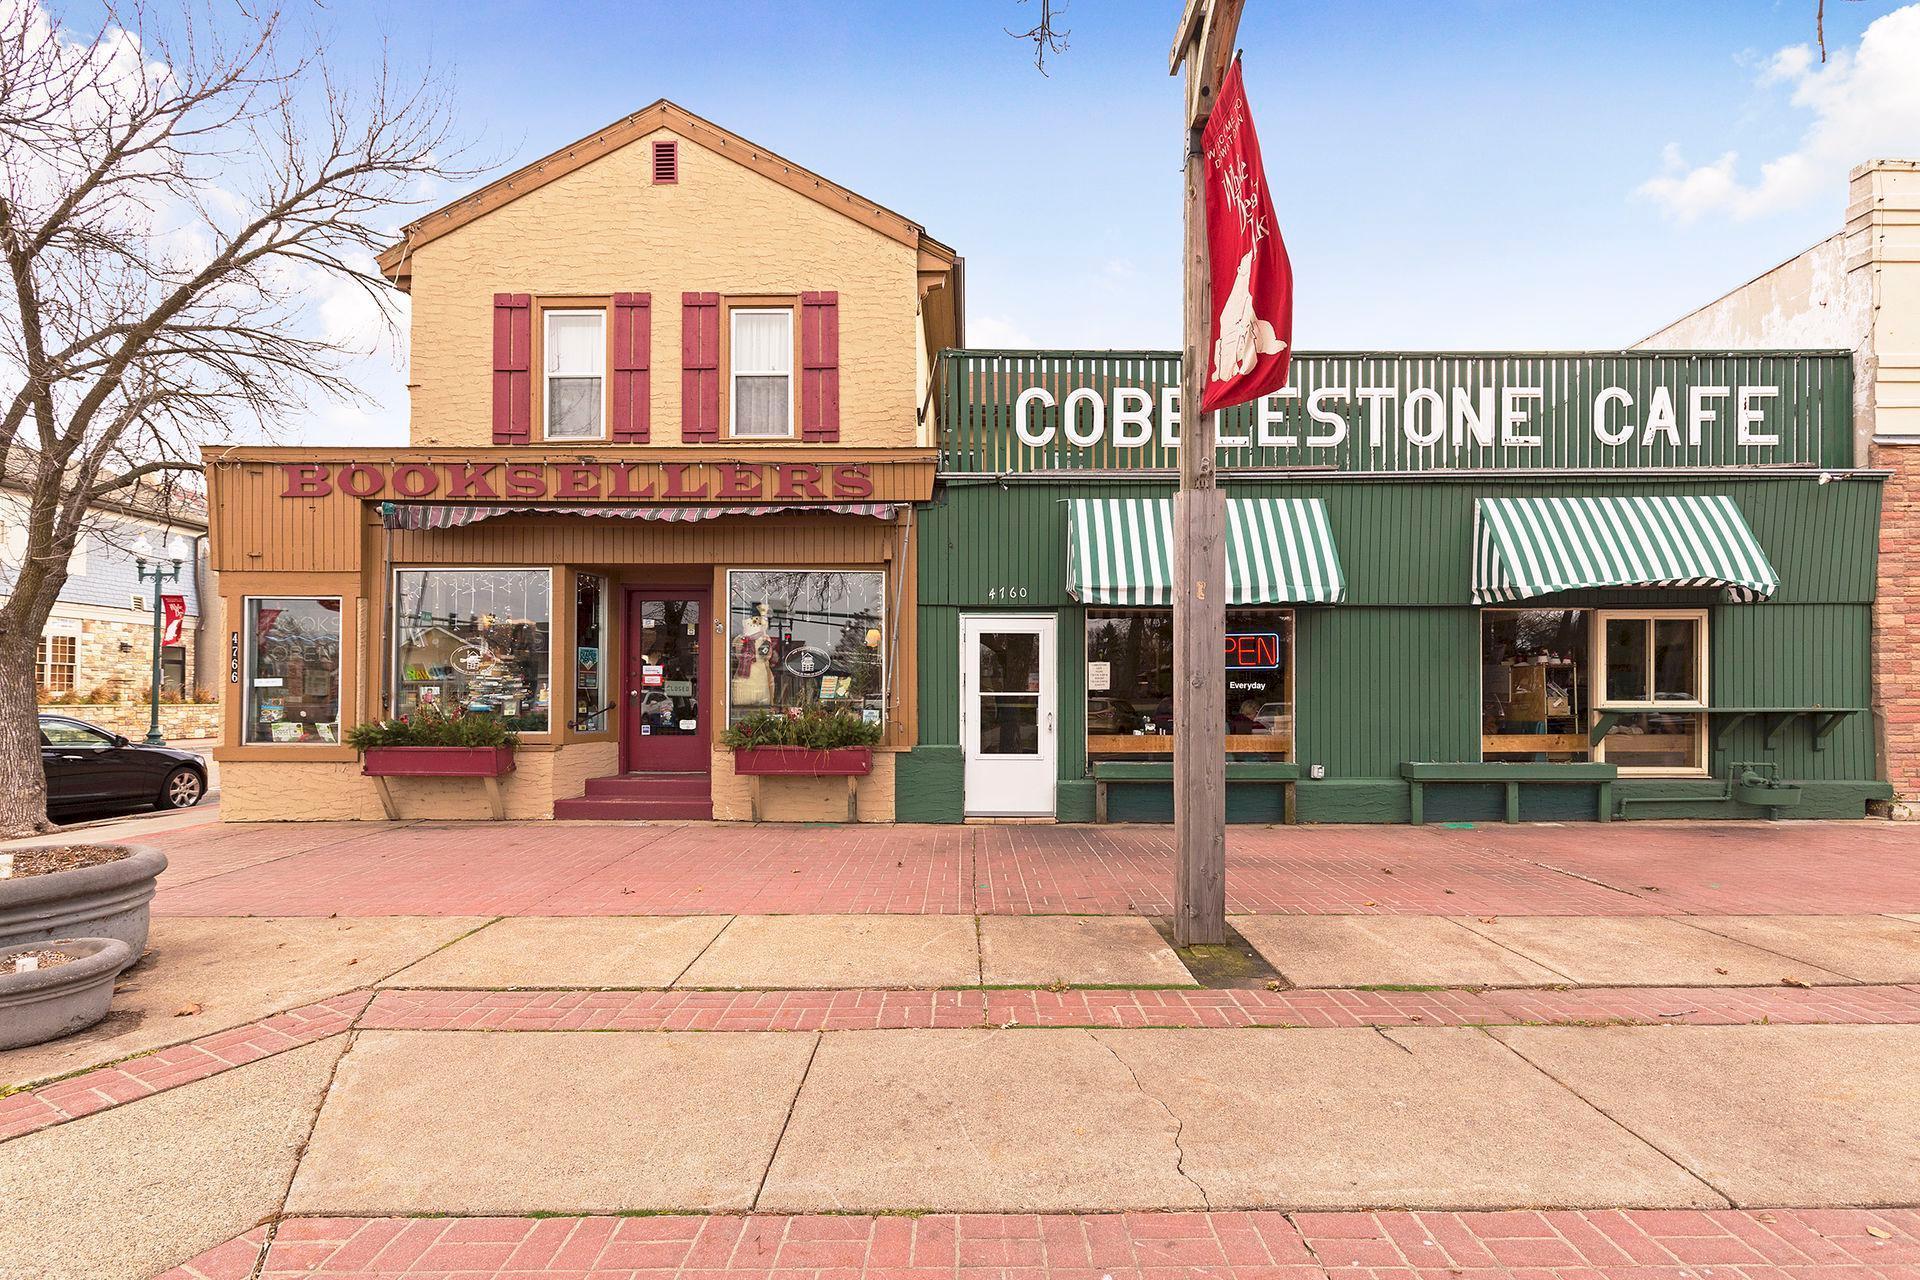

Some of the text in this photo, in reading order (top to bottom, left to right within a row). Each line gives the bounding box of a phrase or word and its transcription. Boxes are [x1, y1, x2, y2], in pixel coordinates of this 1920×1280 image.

[1593, 386, 1780, 447] CAFE
[280, 464, 873, 497] BOOKSELLERS
[988, 586, 1027, 600] 4760
[231, 632, 239, 683] 4766
[1225, 636, 1276, 665] PEN
[1229, 681, 1266, 691] Everyday
